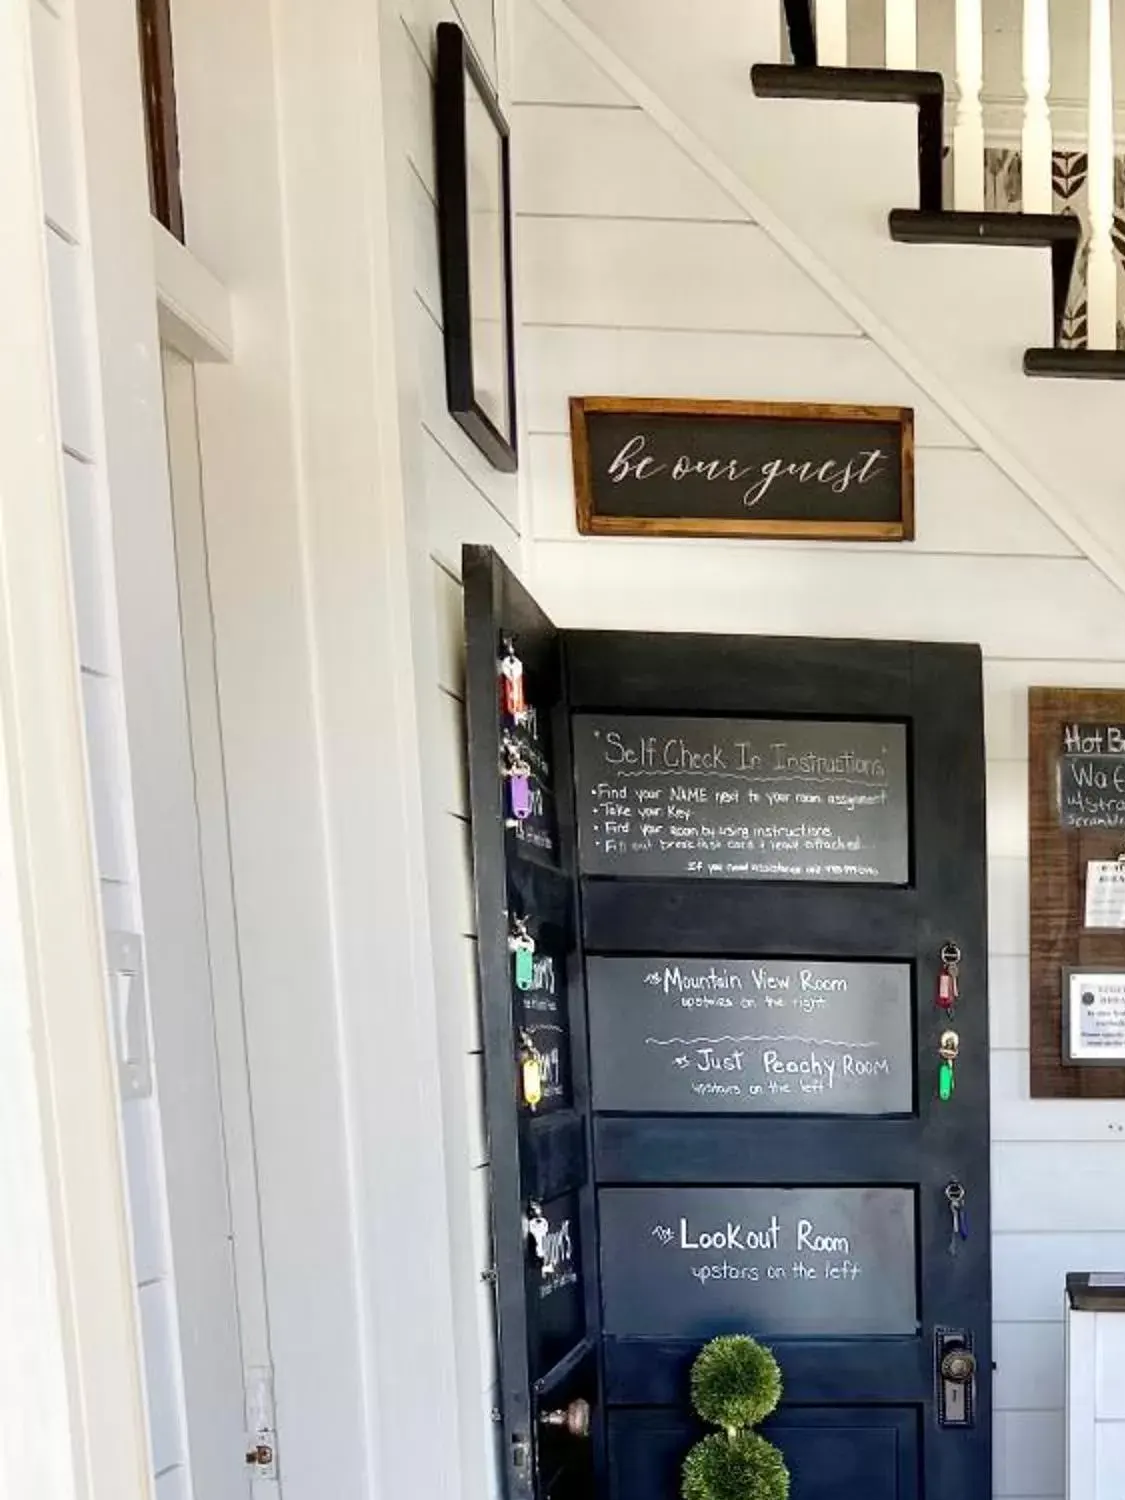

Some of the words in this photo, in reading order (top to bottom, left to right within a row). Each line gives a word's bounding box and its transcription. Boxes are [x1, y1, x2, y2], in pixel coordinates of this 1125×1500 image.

[607, 435, 667, 484] be
[671, 455, 752, 482] our
[743, 450, 889, 506] guest
[605, 732, 656, 766] Self
[663, 738, 727, 770] Check
[734, 742, 762, 772] In
[1064, 724, 1103, 753] Hot
[597, 783, 628, 799] Find
[635, 788, 663, 803] your
[669, 786, 708, 802] NAME
[600, 801, 632, 817] Take
[604, 821, 630, 835] Find
[663, 966, 743, 994] Mountain
[752, 966, 790, 991] View
[800, 968, 848, 992] Room
[697, 1048, 745, 1071] Just
[763, 1050, 835, 1089] Peachy
[797, 1218, 850, 1255] Room
[766, 1266, 787, 1279] on
[792, 1260, 817, 1280] the
[824, 1259, 863, 1281] left
